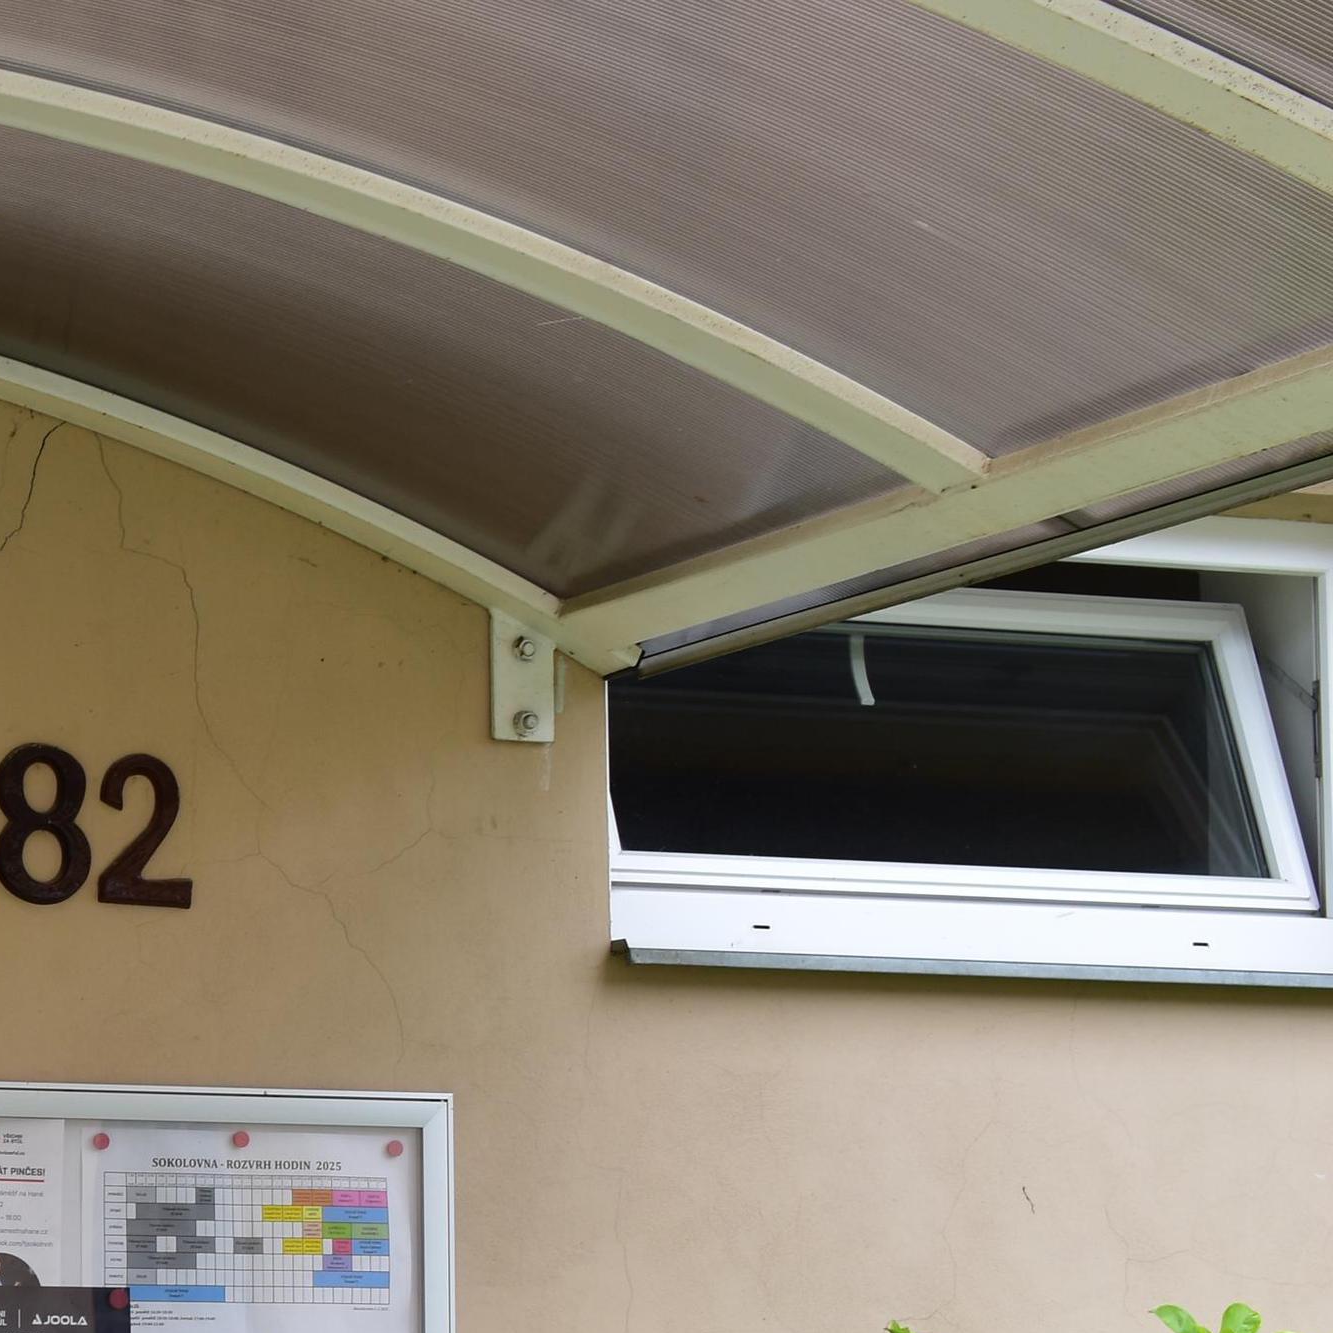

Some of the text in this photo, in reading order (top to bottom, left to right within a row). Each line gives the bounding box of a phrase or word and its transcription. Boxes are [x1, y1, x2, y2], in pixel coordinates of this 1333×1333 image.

[152, 1158, 342, 1171] SOKOLOVNA ROZVRH HODIN 2025
[11, 1167, 45, 1176] PINČES!
